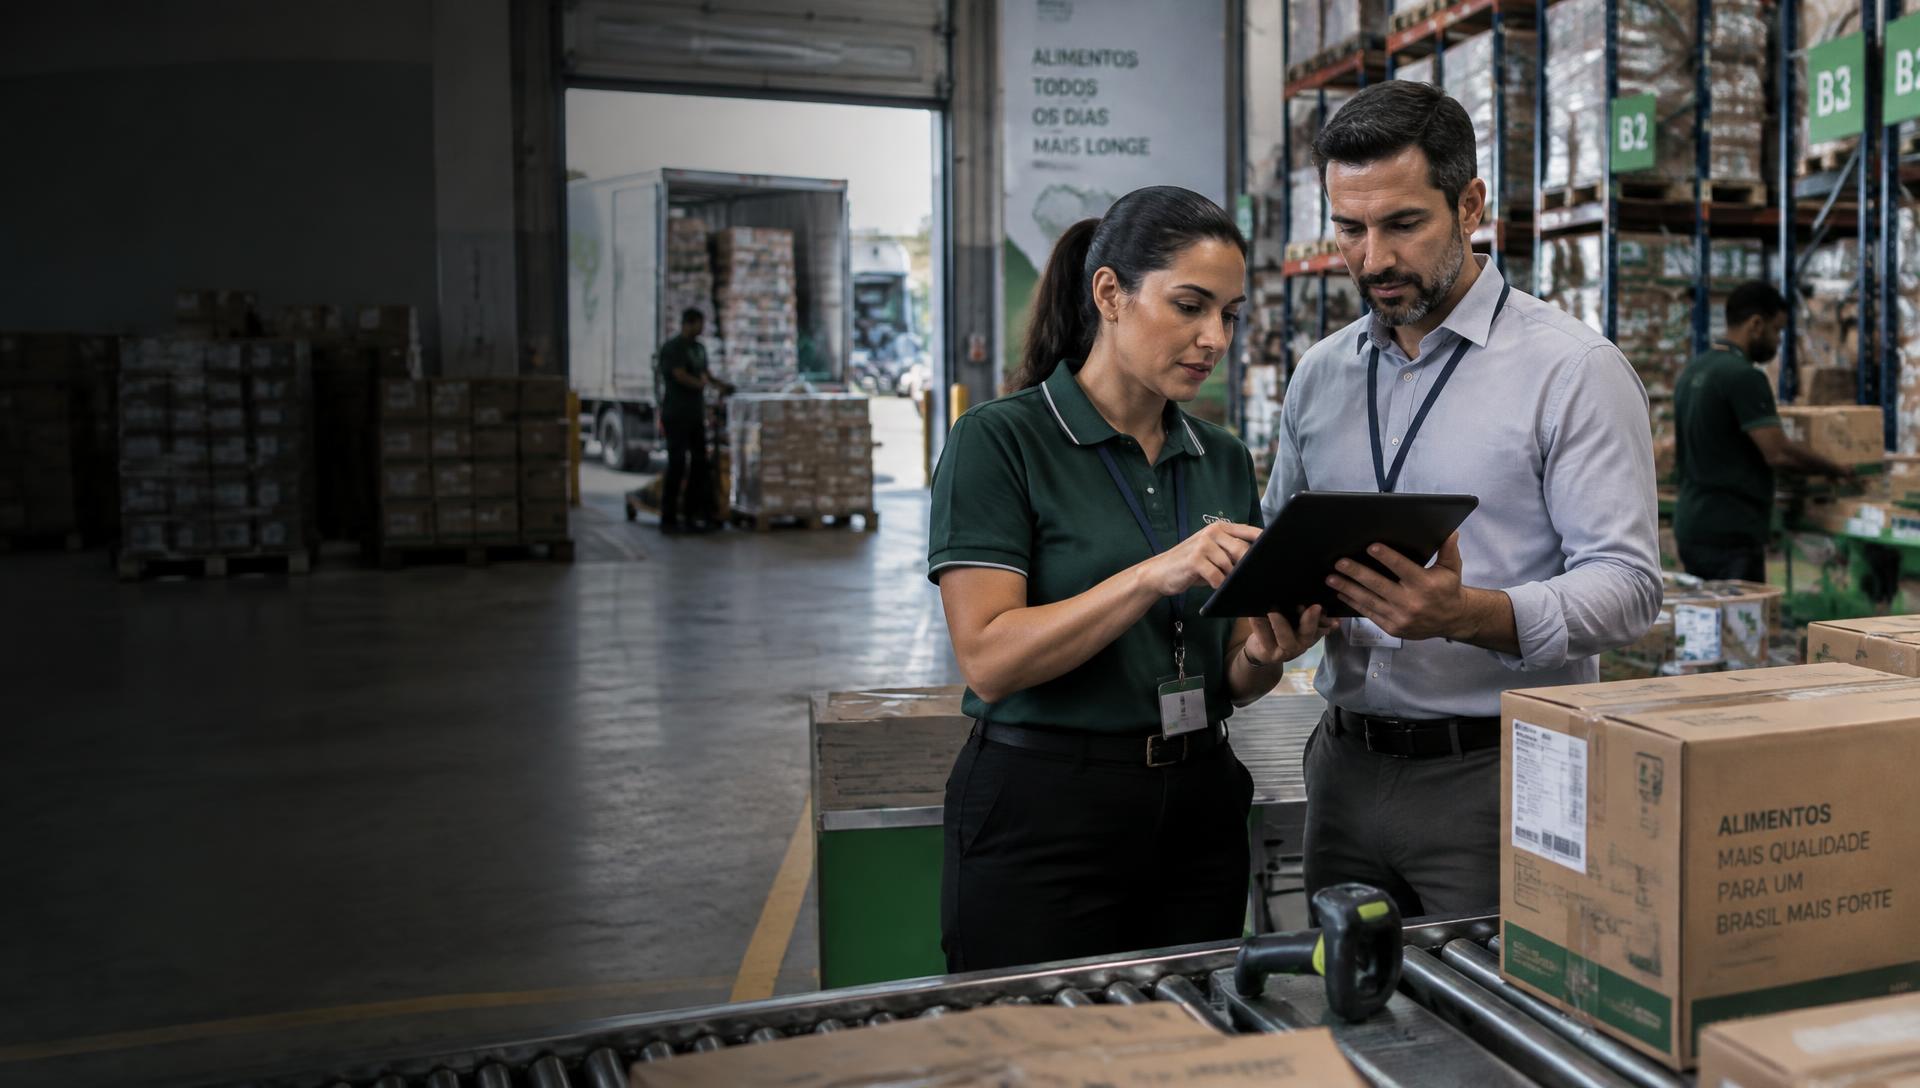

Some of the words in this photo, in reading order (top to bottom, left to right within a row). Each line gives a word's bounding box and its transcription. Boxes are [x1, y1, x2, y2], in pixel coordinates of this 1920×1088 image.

[1032, 49, 1139, 68] ALIMENTOS
[1032, 77, 1098, 97] TODOS
[1817, 66, 1851, 117] B3
[1031, 106, 1060, 127] OS
[1063, 106, 1110, 127] DIAS
[1619, 113, 1648, 151] B2
[1032, 136, 1081, 155] MAIS
[1085, 137, 1150, 156] LONGE
[1717, 803, 1832, 836] ALIMENTOS
[1717, 845, 1764, 870] MAIS
[1769, 830, 1871, 864] QUALIDADE
[1717, 877, 1768, 903] PARA
[1774, 872, 1804, 894] UM
[1716, 907, 1782, 935] BRASIL
[1787, 899, 1832, 924] MAIS
[1837, 888, 1893, 917] FORTE
